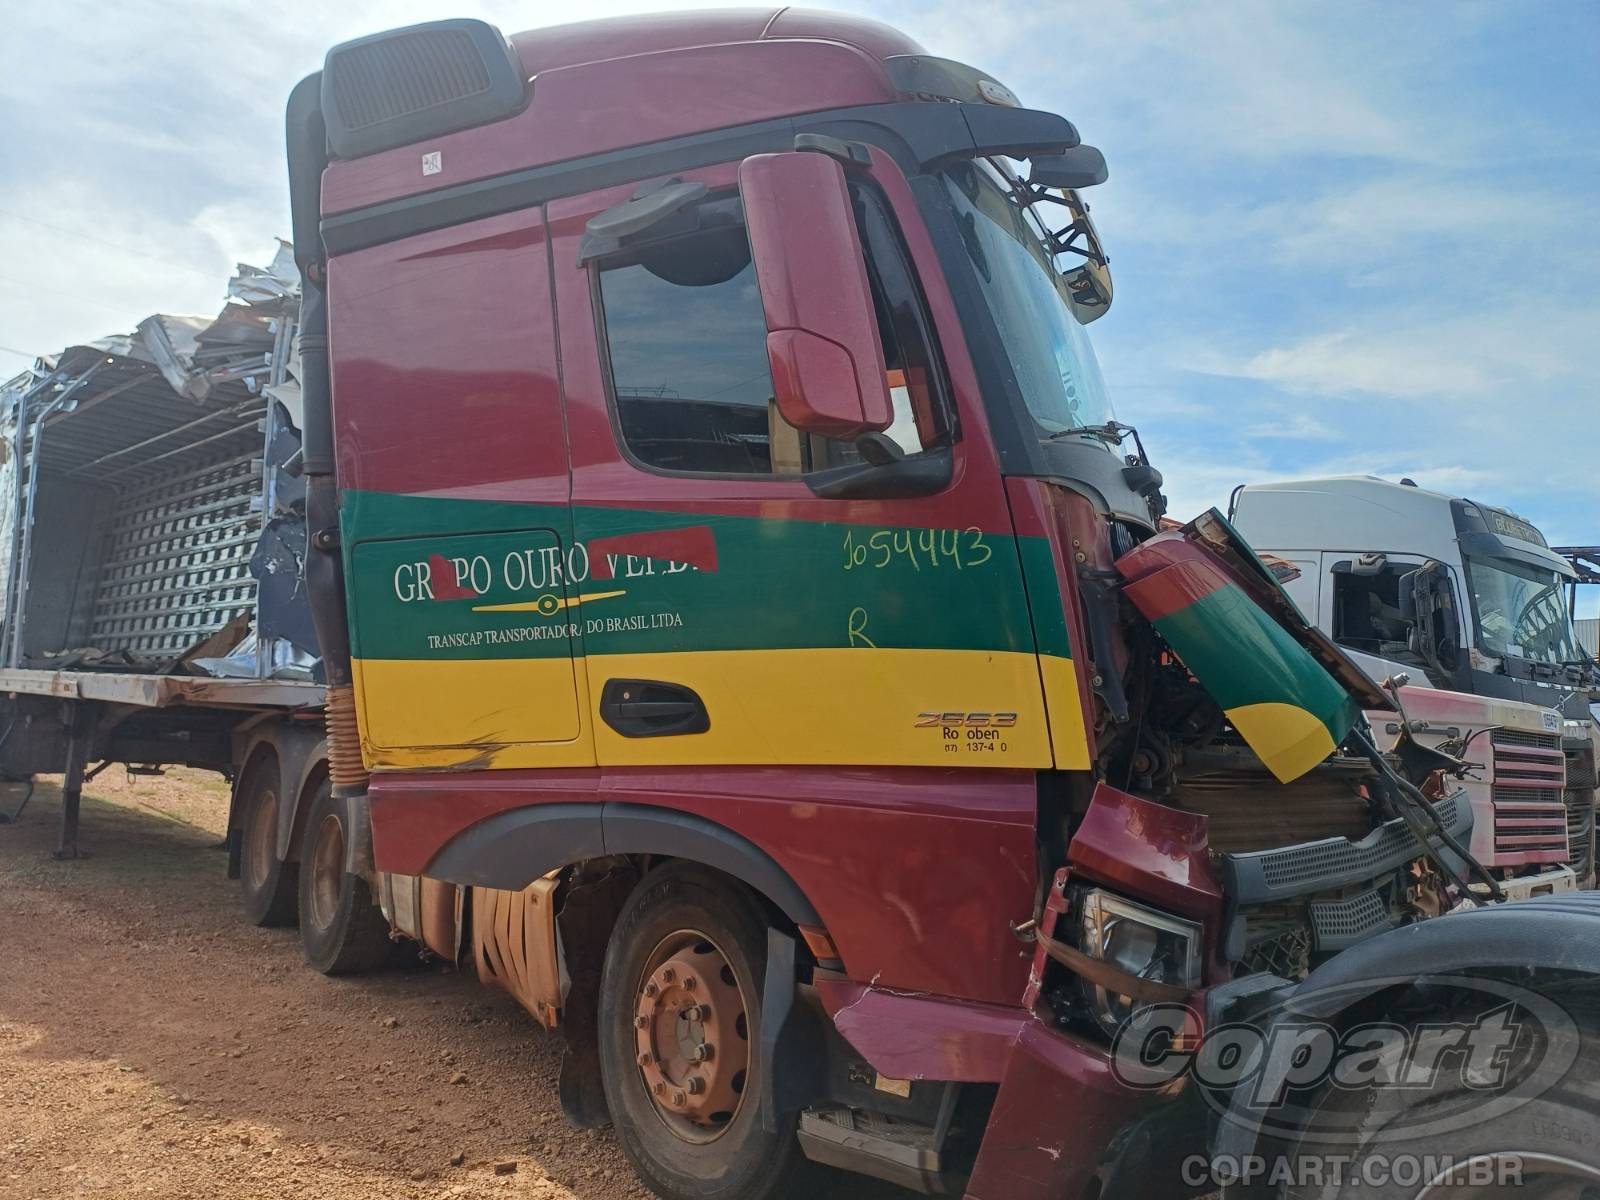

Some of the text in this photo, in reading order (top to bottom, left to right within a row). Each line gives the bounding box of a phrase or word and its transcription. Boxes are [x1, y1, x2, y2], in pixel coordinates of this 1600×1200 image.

[844, 526, 993, 571] 1054443
[394, 555, 492, 602] GRPO
[503, 542, 589, 591] OURO
[428, 631, 482, 649] TRANSCAP
[587, 619, 604, 634] DO
[607, 616, 650, 632] BRASIL
[651, 613, 684, 628] LTDA
[848, 607, 876, 648] R
